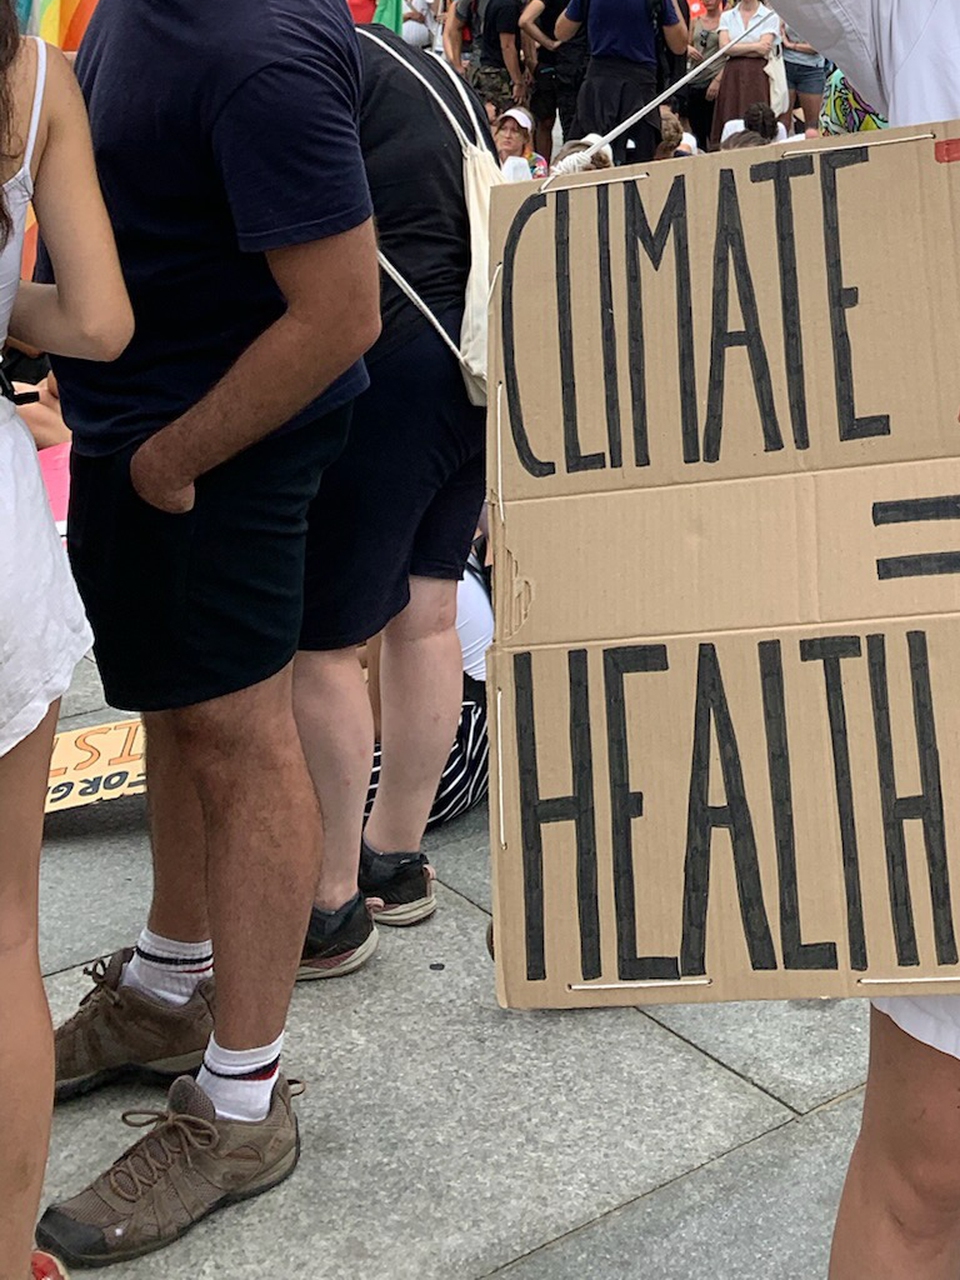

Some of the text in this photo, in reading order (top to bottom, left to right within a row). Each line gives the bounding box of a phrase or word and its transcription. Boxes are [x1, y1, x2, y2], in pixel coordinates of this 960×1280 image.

[502, 146, 890, 478] CLIMATE
[48, 770, 146, 803] FORG
[512, 629, 960, 982] HEALTH
